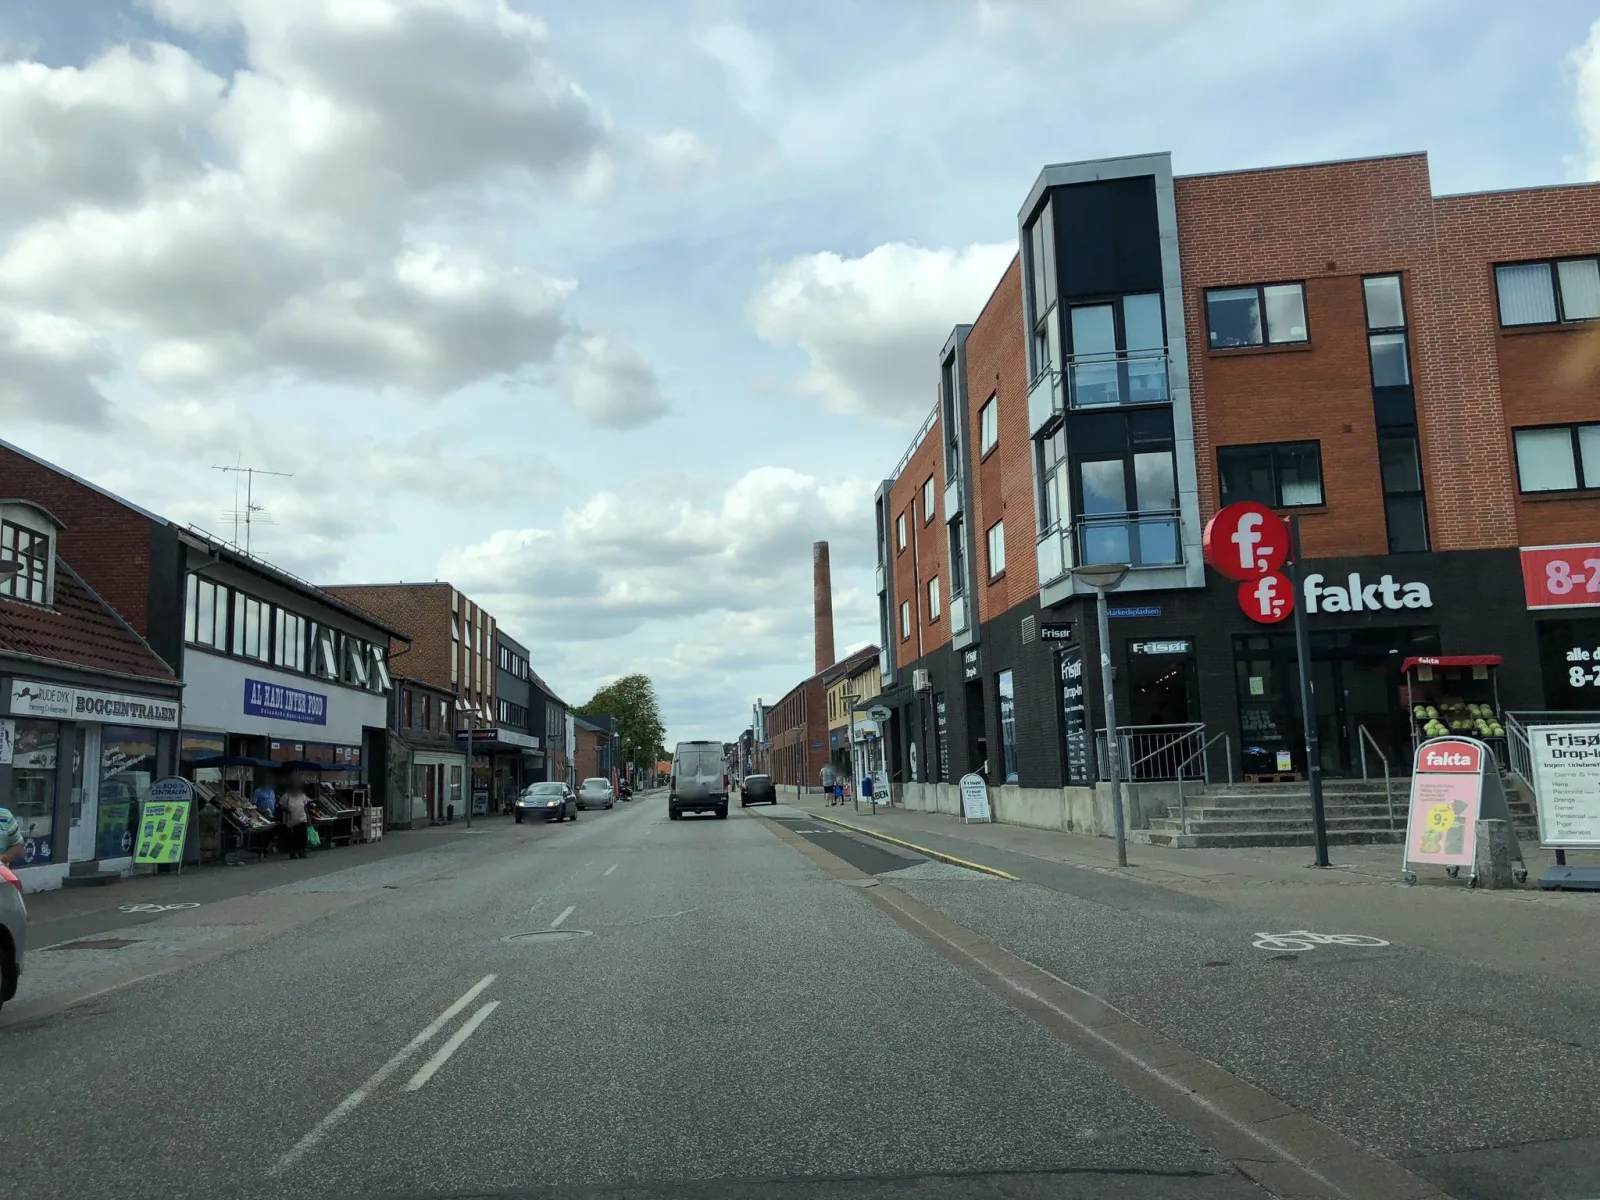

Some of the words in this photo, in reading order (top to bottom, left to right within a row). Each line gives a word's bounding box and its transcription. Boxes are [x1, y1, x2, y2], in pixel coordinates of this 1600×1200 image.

[1303, 573, 1433, 613] fakta
[1041, 629, 1071, 638] Frisør
[1132, 642, 1189, 653] Frisør
[1566, 647, 1590, 661] alle
[1061, 661, 1082, 680] Frisør
[38, 688, 56, 702] RUDE
[57, 690, 70, 703] DYK
[250, 682, 262, 705] AL
[264, 686, 284, 708] HADI
[285, 690, 306, 713] INTER
[308, 695, 323, 715] FOOD
[75, 696, 177, 722] BOGCENTRALEN
[1426, 751, 1471, 766] fakta
[1552, 748, 1600, 760] Drop-I
[151, 788, 188, 796] CENTRALEN
